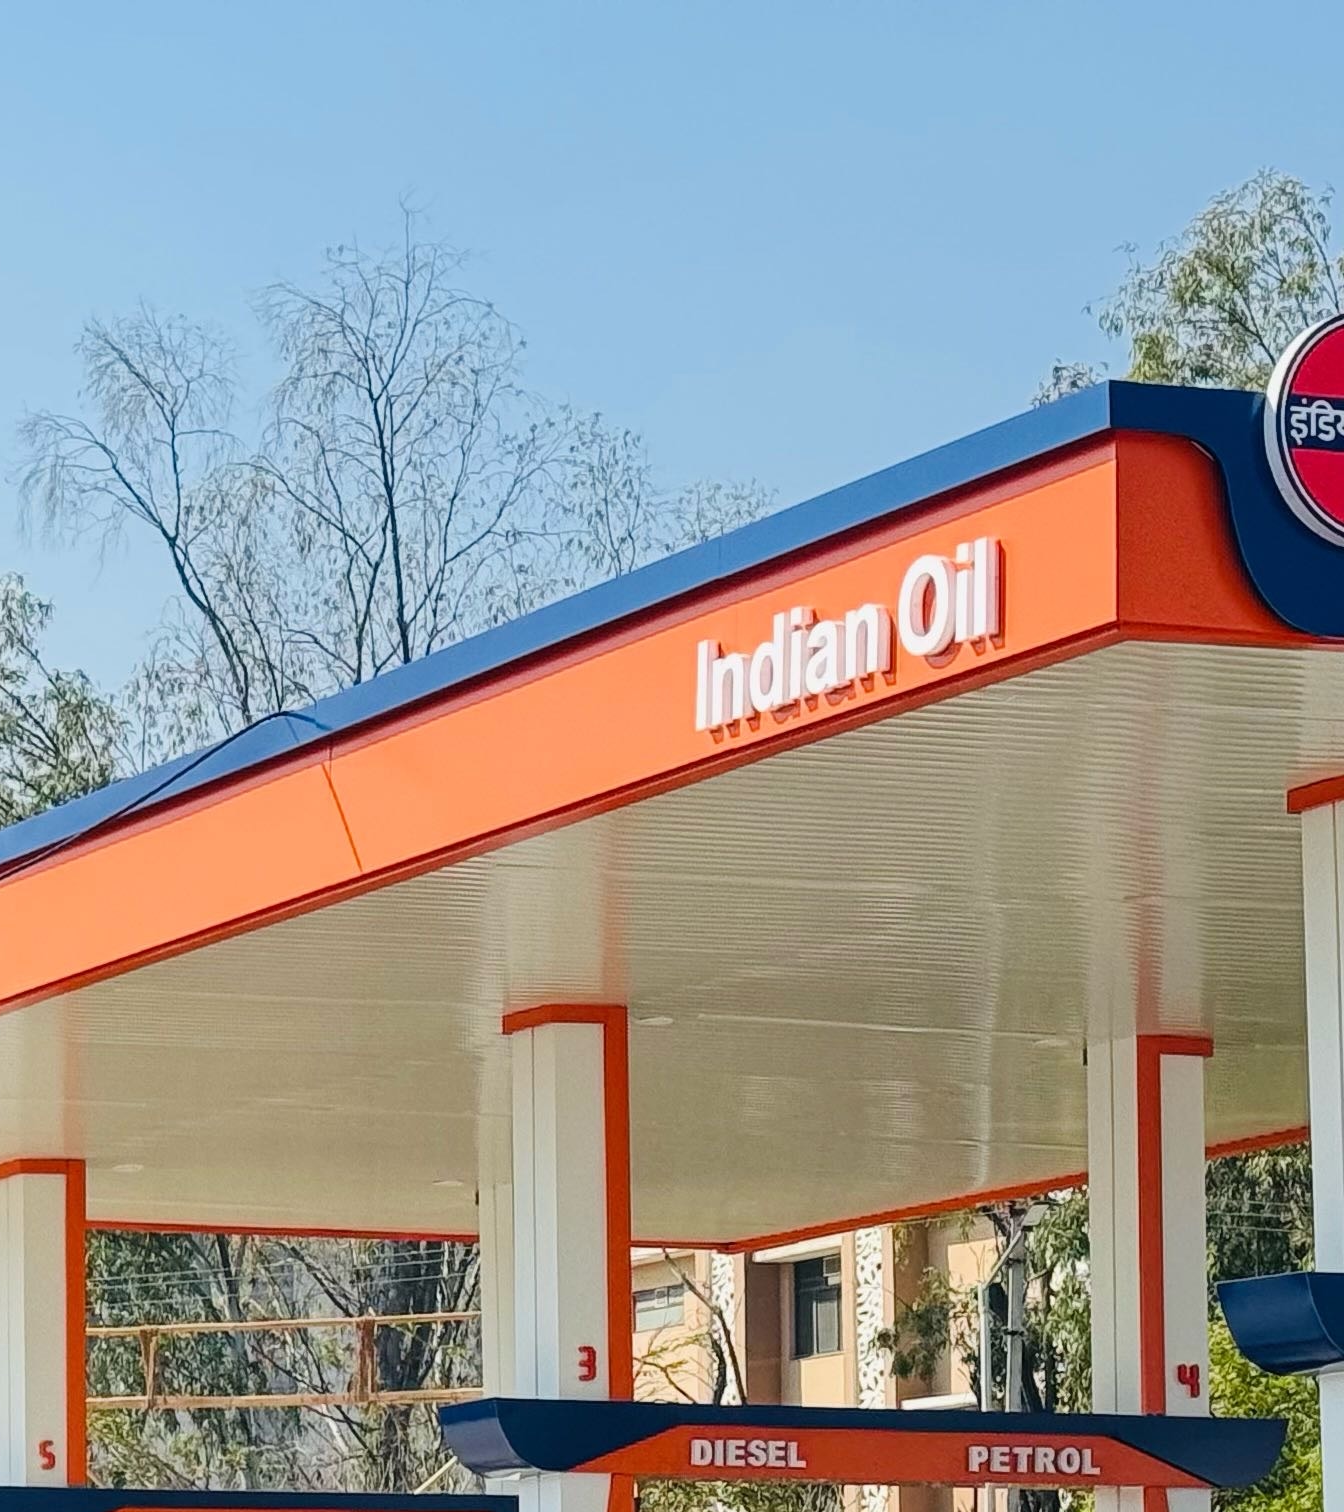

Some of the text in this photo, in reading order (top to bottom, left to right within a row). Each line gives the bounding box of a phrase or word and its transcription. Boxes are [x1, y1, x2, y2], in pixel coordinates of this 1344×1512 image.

[695, 536, 1000, 732] Indian Oil
[578, 1345, 597, 1382] 3
[1177, 1363, 1201, 1399] 4
[38, 1439, 57, 1471] 5
[690, 1438, 808, 1469] DIESEL
[968, 1445, 1102, 1476] PETROL
